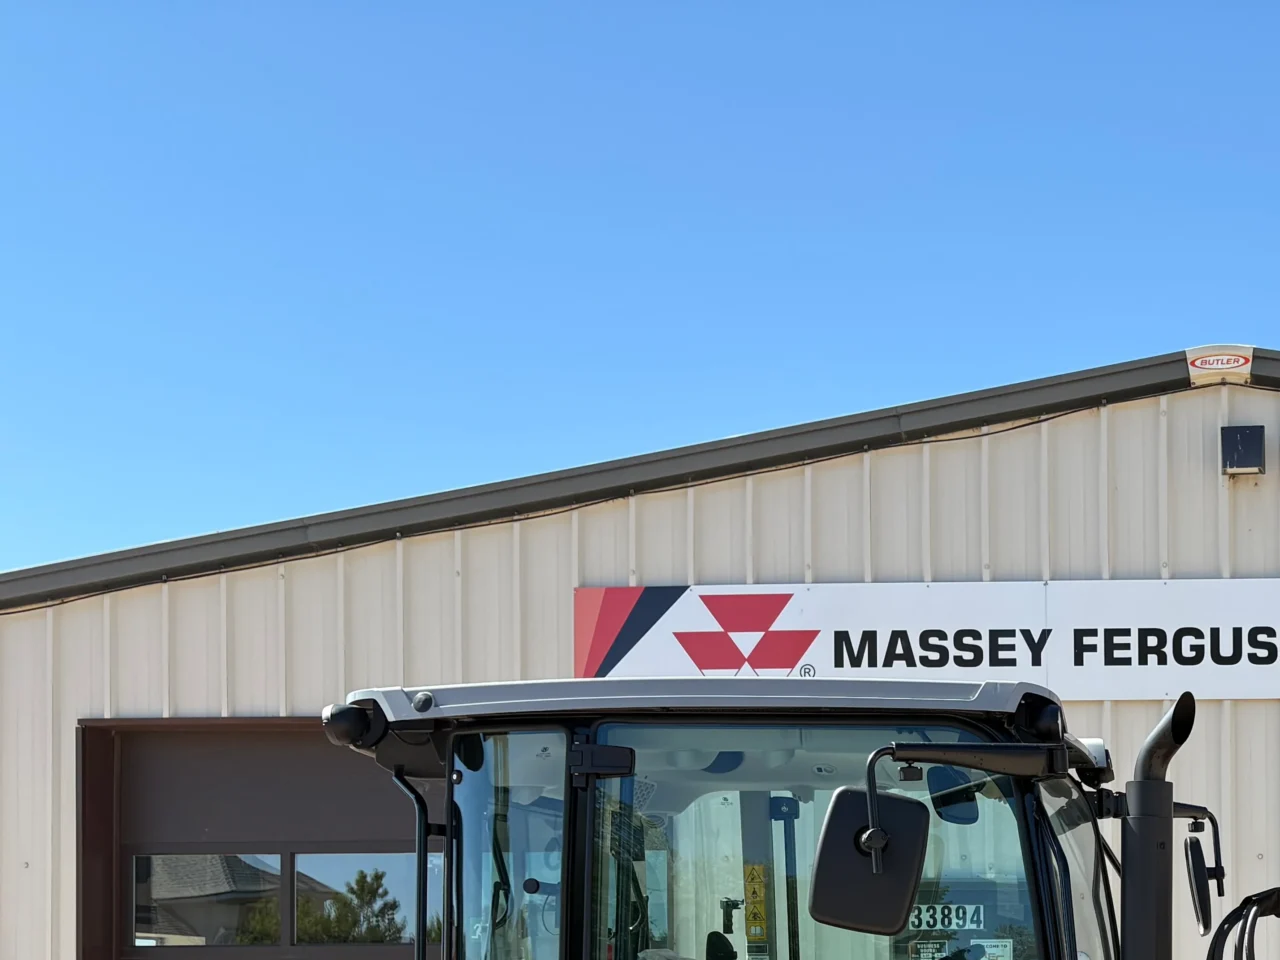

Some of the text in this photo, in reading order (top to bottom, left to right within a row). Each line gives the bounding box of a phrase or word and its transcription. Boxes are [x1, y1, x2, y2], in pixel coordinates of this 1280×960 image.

[1200, 358, 1241, 366] BUTLER
[833, 628, 1053, 669] MASSEY
[911, 905, 982, 929] 33894
